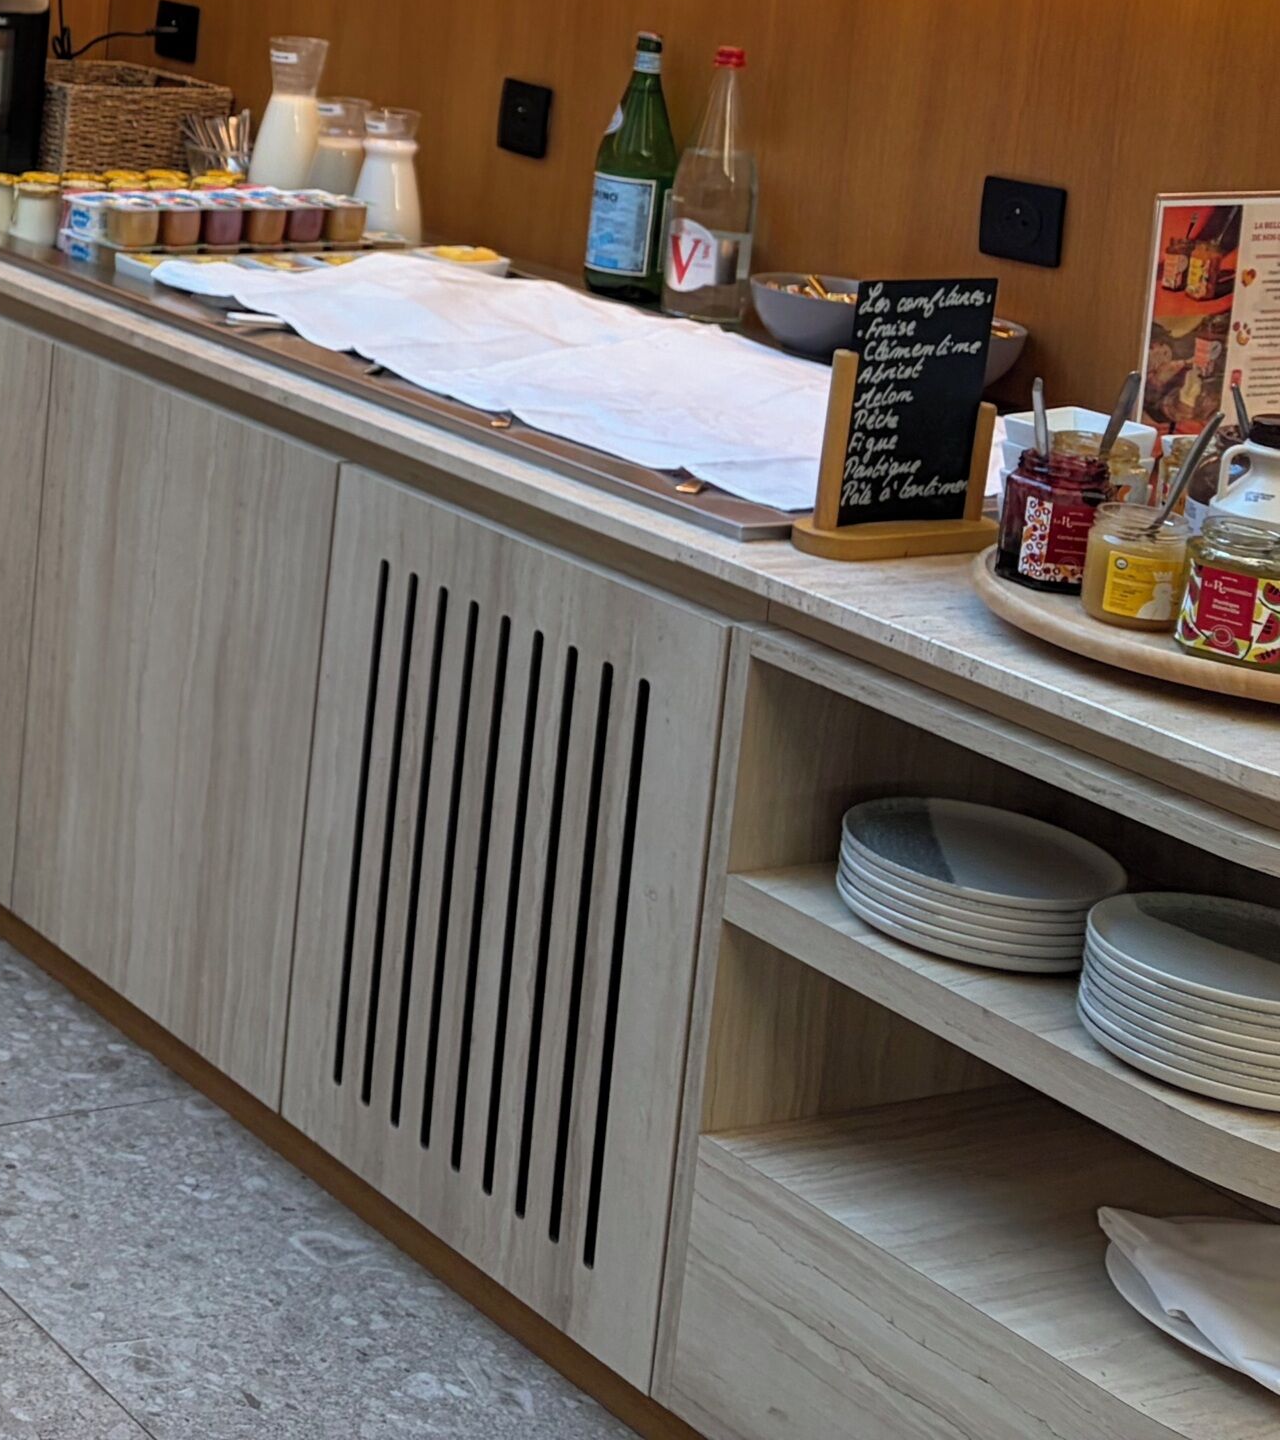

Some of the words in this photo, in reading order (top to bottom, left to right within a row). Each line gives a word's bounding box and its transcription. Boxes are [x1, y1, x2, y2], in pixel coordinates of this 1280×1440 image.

[858, 282, 890, 315] Les
[865, 317, 917, 341] Fraise
[863, 333, 982, 362] Clémentine
[858, 357, 924, 384] Abricot
[854, 383, 914, 410] Melon
[854, 408, 899, 430] Pêche
[848, 432, 898, 464] Figue
[843, 456, 922, 487] Pastèque
[840, 481, 872, 507] Pâte
[878, 484, 898, 502] à
